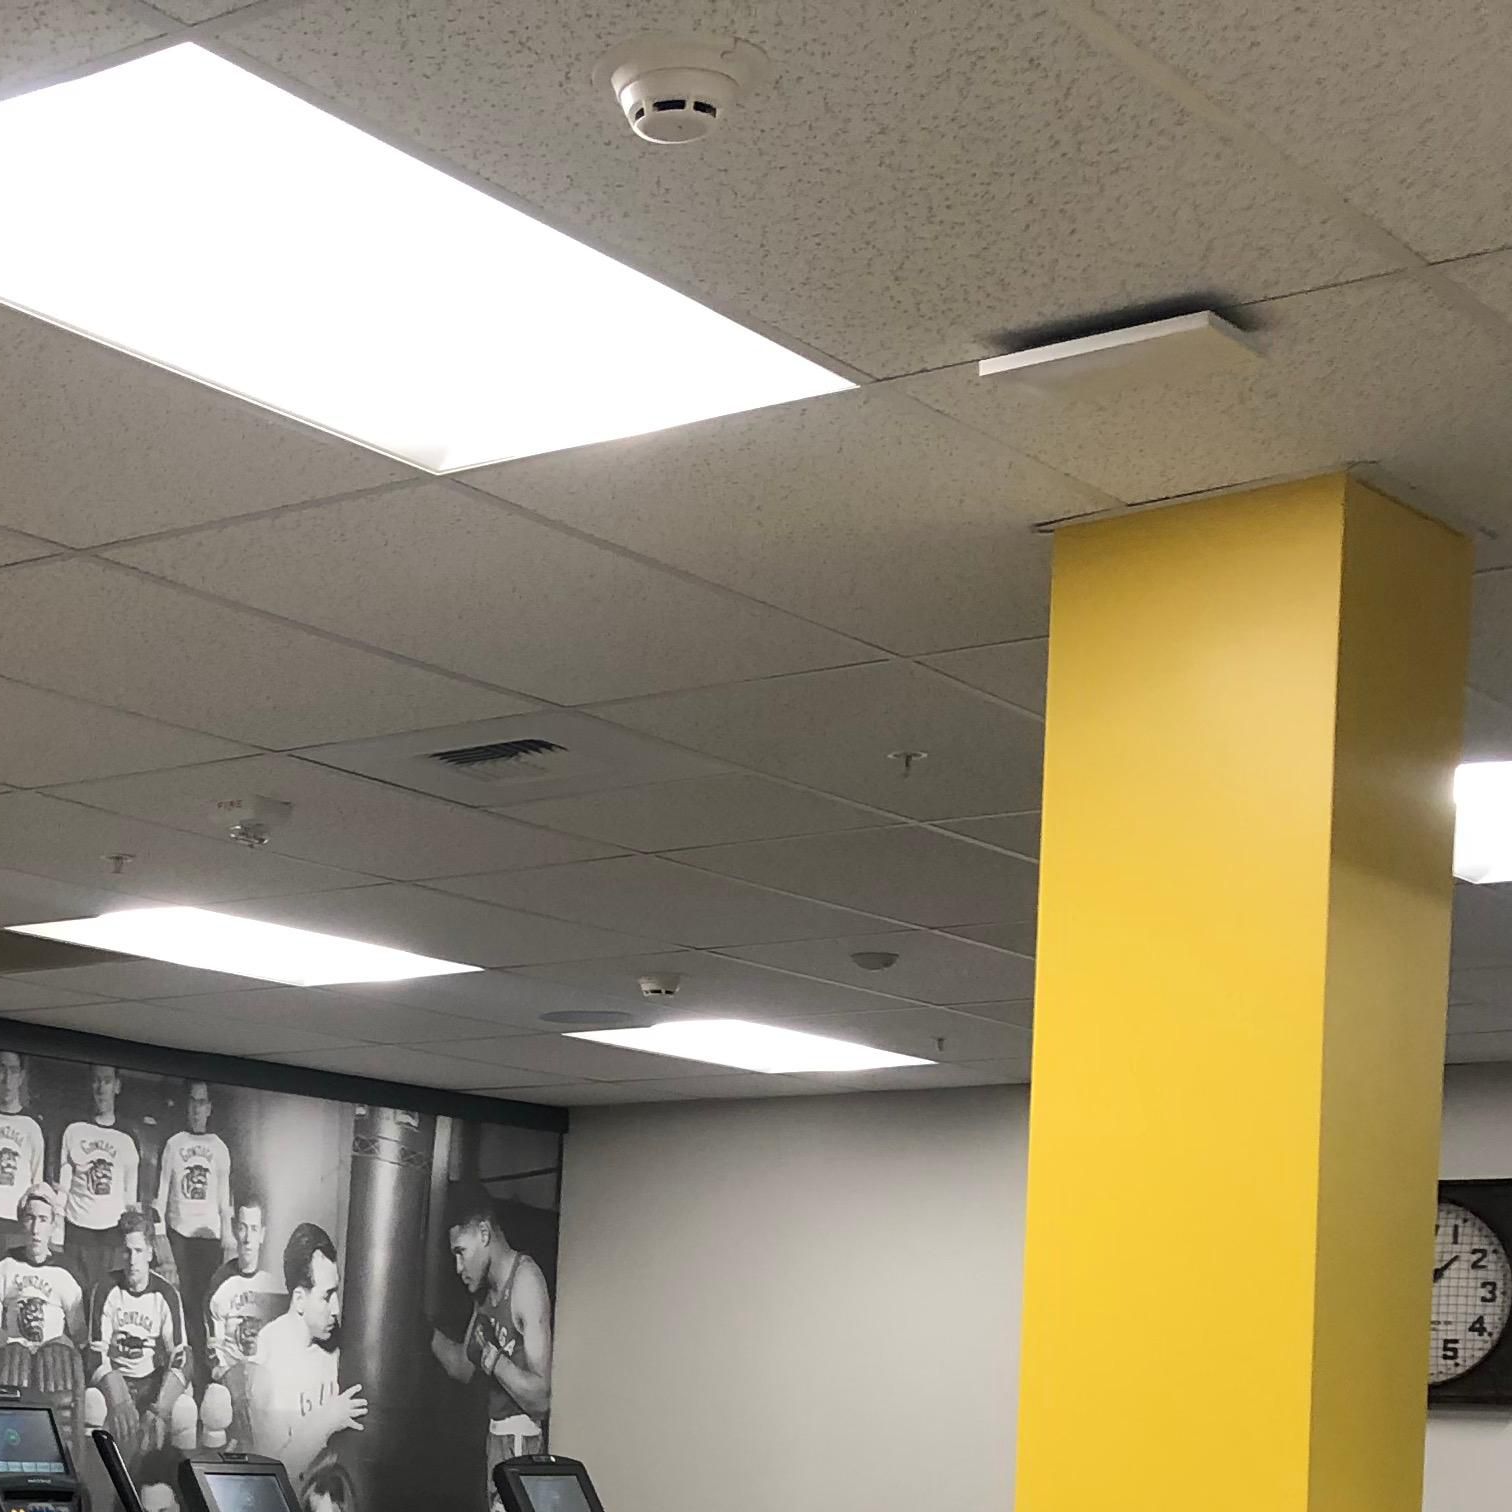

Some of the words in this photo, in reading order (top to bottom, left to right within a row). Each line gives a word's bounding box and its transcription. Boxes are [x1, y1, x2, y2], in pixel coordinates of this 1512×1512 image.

[1453, 1223, 1459, 1245] 1
[1470, 1248, 1487, 1270] 2
[1480, 1281, 1497, 1303] 3
[1468, 1315, 1486, 1337] 4
[1442, 1338, 1460, 1361] 5
